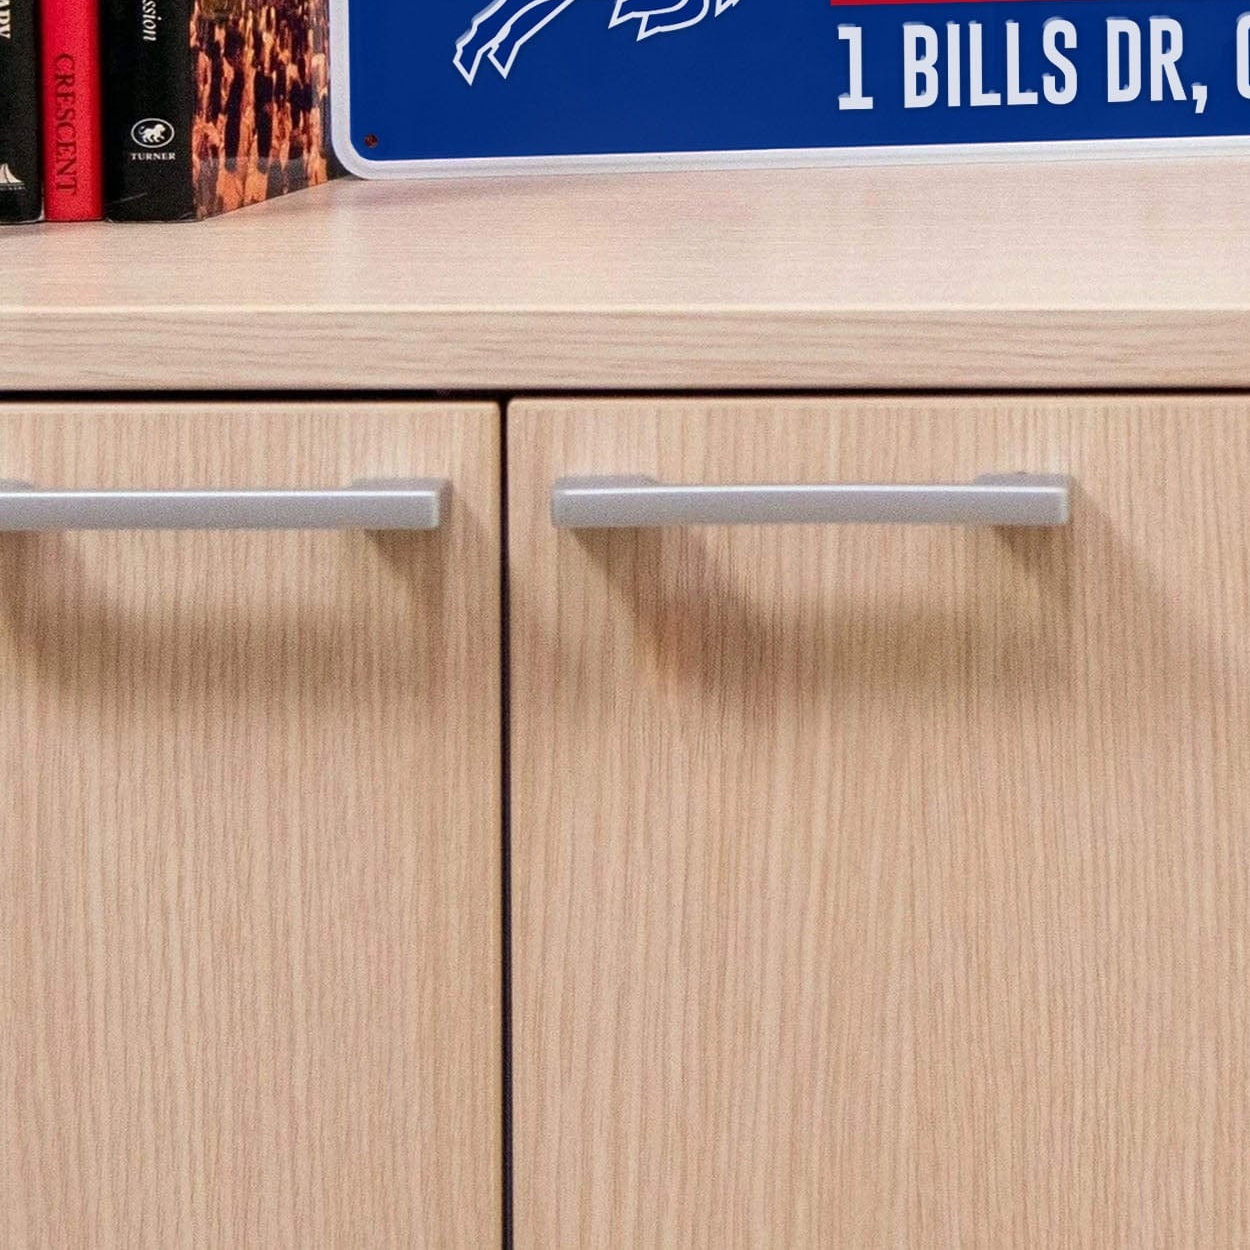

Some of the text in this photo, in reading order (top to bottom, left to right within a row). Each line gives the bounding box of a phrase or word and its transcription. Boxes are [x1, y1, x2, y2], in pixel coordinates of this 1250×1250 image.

[838, 24, 874, 110] 1
[903, 18, 1078, 109] BILLS
[1106, 16, 1208, 114] DR,
[55, 53, 77, 194] CRESCENT
[130, 152, 176, 160] TURNER
